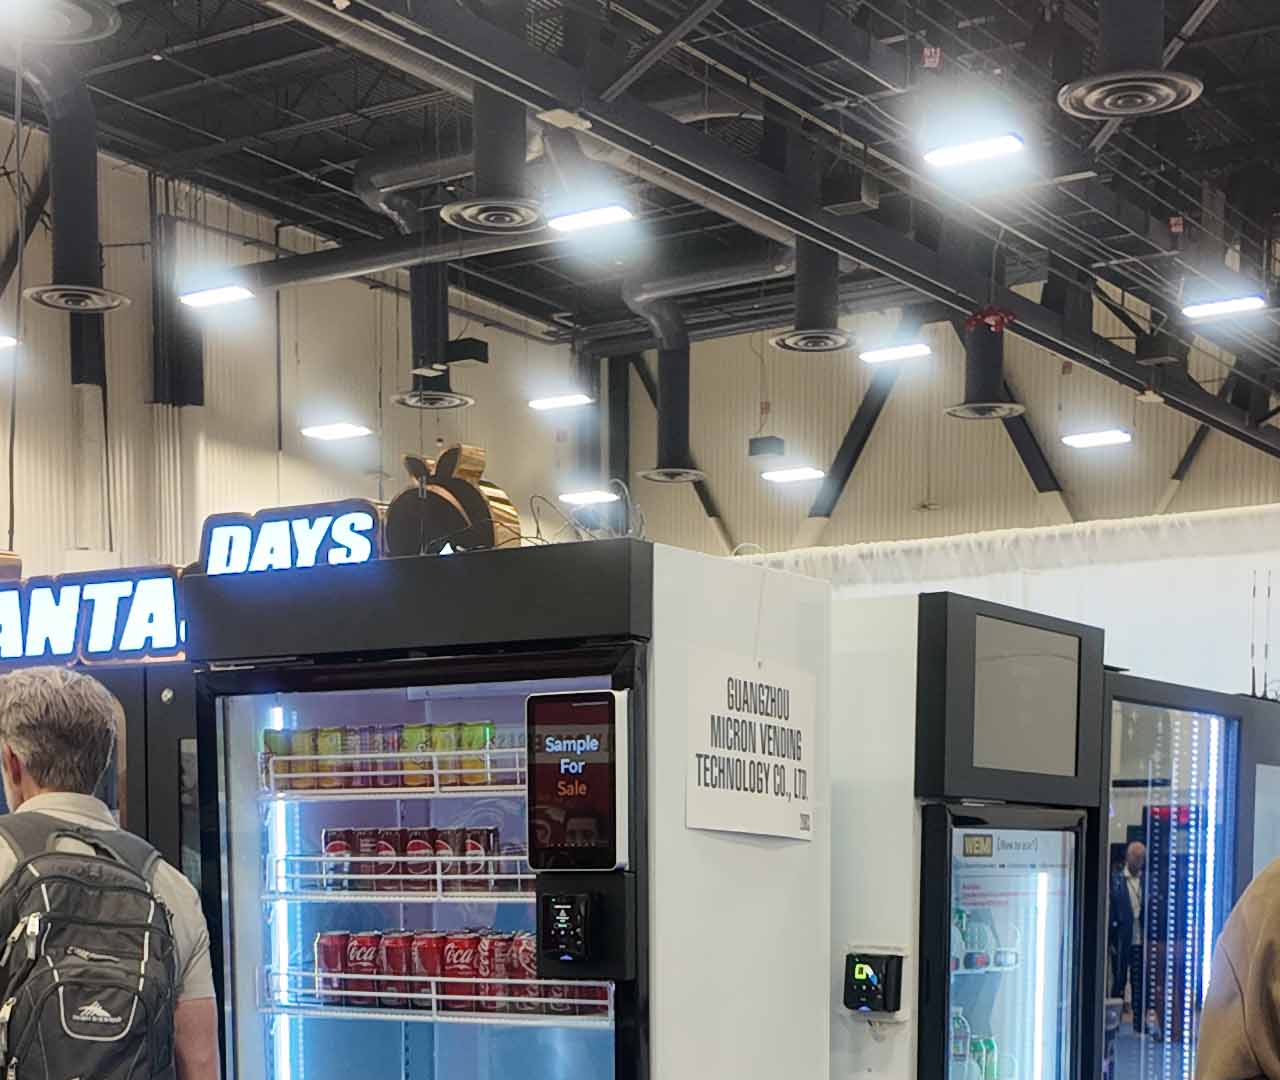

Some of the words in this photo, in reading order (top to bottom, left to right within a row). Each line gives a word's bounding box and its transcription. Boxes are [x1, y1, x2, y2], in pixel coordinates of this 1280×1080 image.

[206, 510, 375, 576] DAYS
[727, 676, 790, 721] GUANGZHOU
[544, 734, 600, 755] Sample
[710, 714, 757, 754] MICRON
[760, 722, 802, 761] VENDING
[559, 757, 586, 775] For
[695, 752, 770, 794] TECHNOLOGY
[794, 767, 809, 801] LTD.
[557, 780, 588, 797] Sale
[347, 939, 376, 962] Coca
[443, 942, 474, 964] Coca
